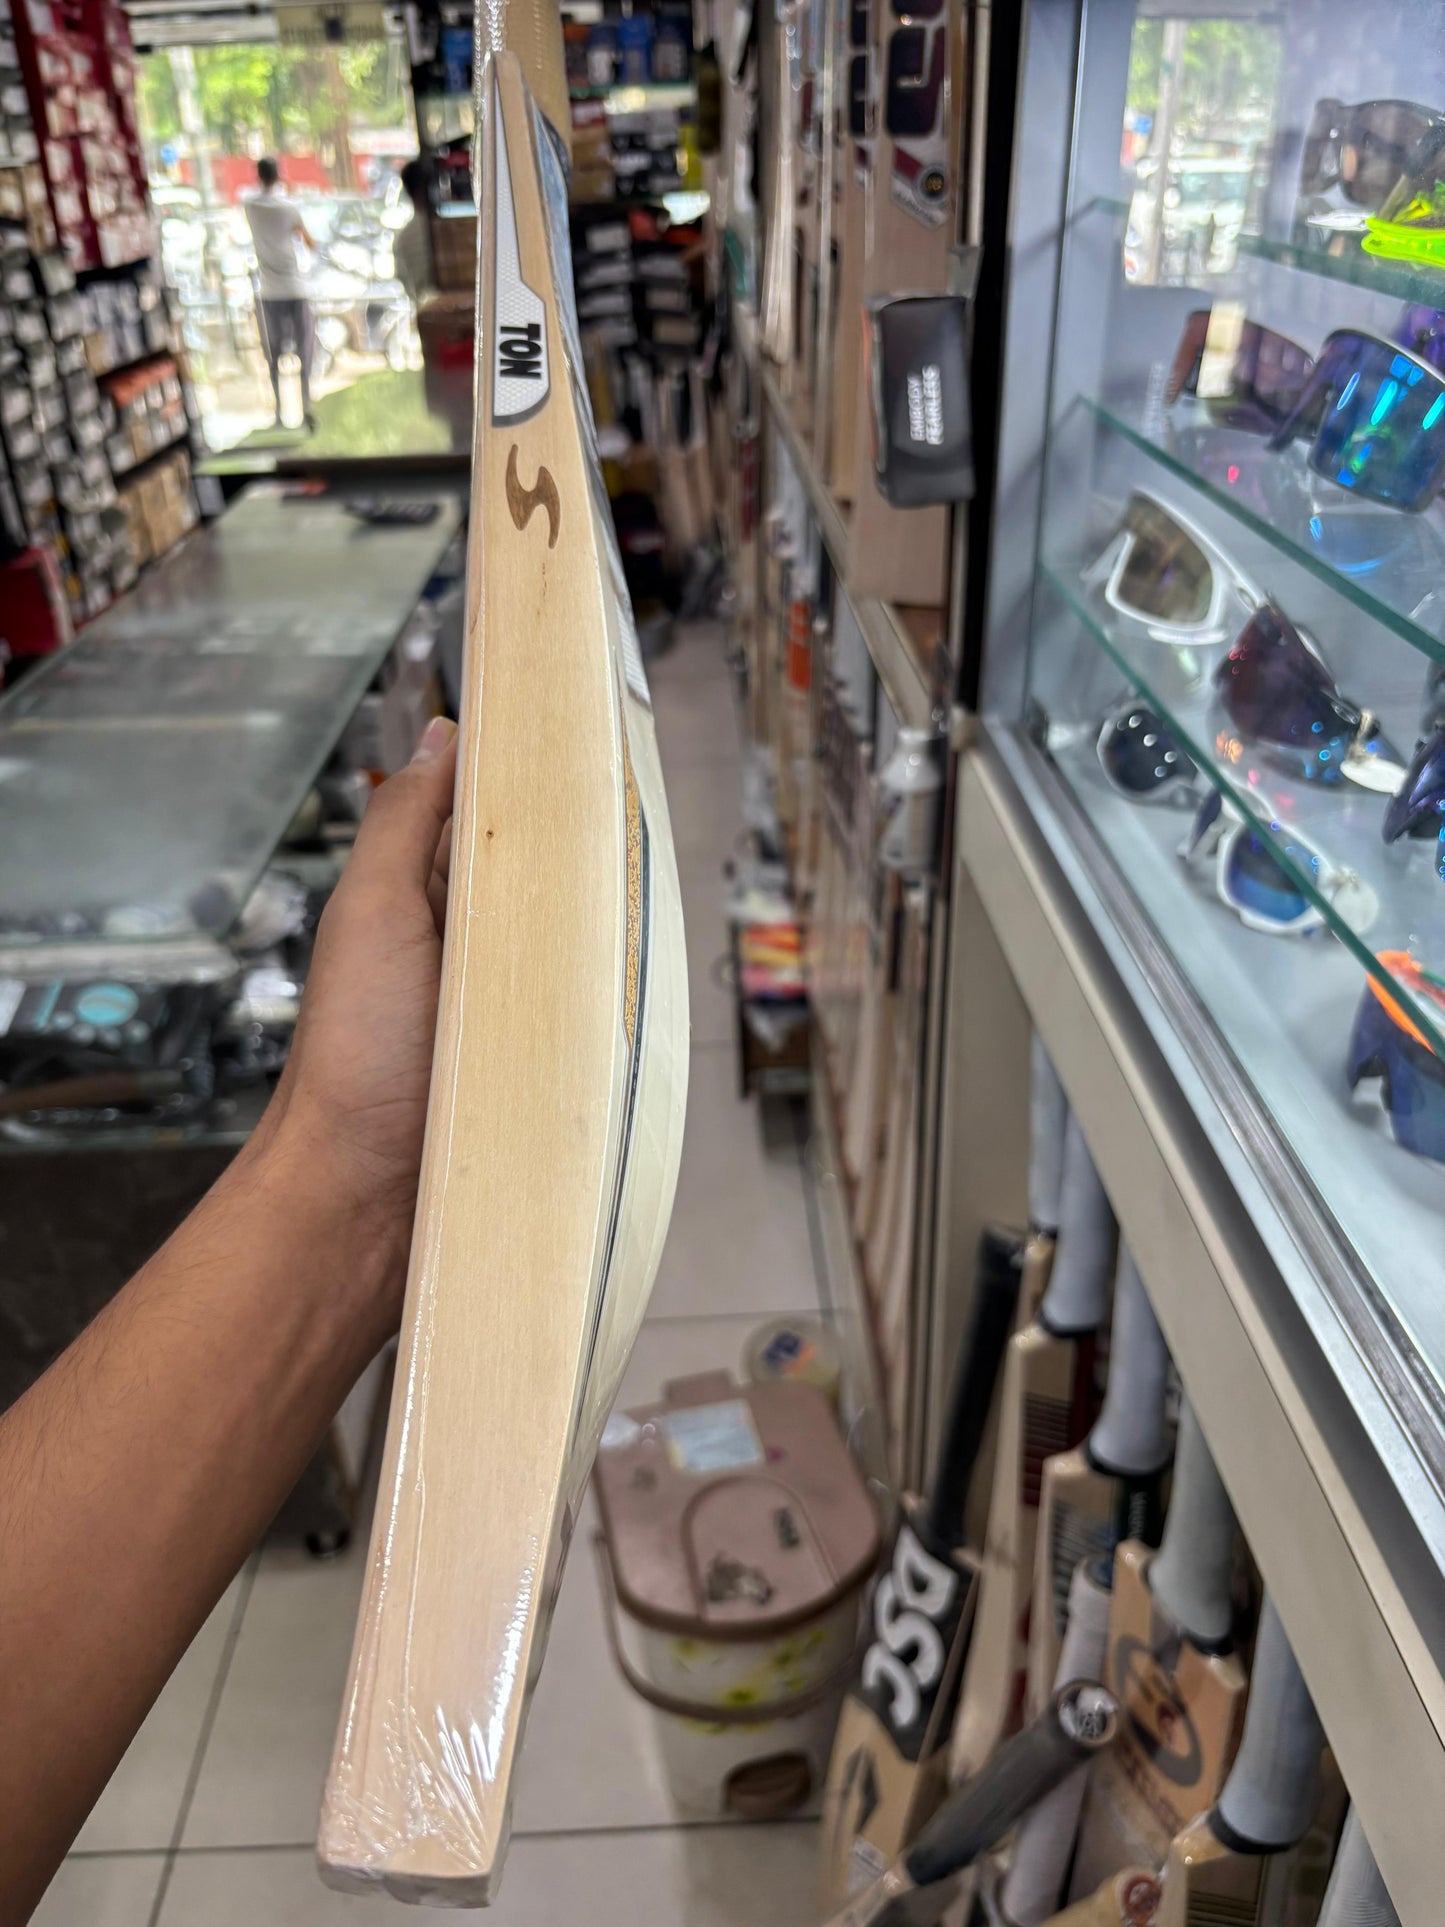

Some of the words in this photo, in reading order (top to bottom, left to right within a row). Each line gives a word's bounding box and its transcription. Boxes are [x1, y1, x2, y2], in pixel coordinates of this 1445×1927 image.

[498, 323, 542, 380] TON
[906, 374, 926, 441] EMBODY
[862, 1524, 959, 1728] DSC
